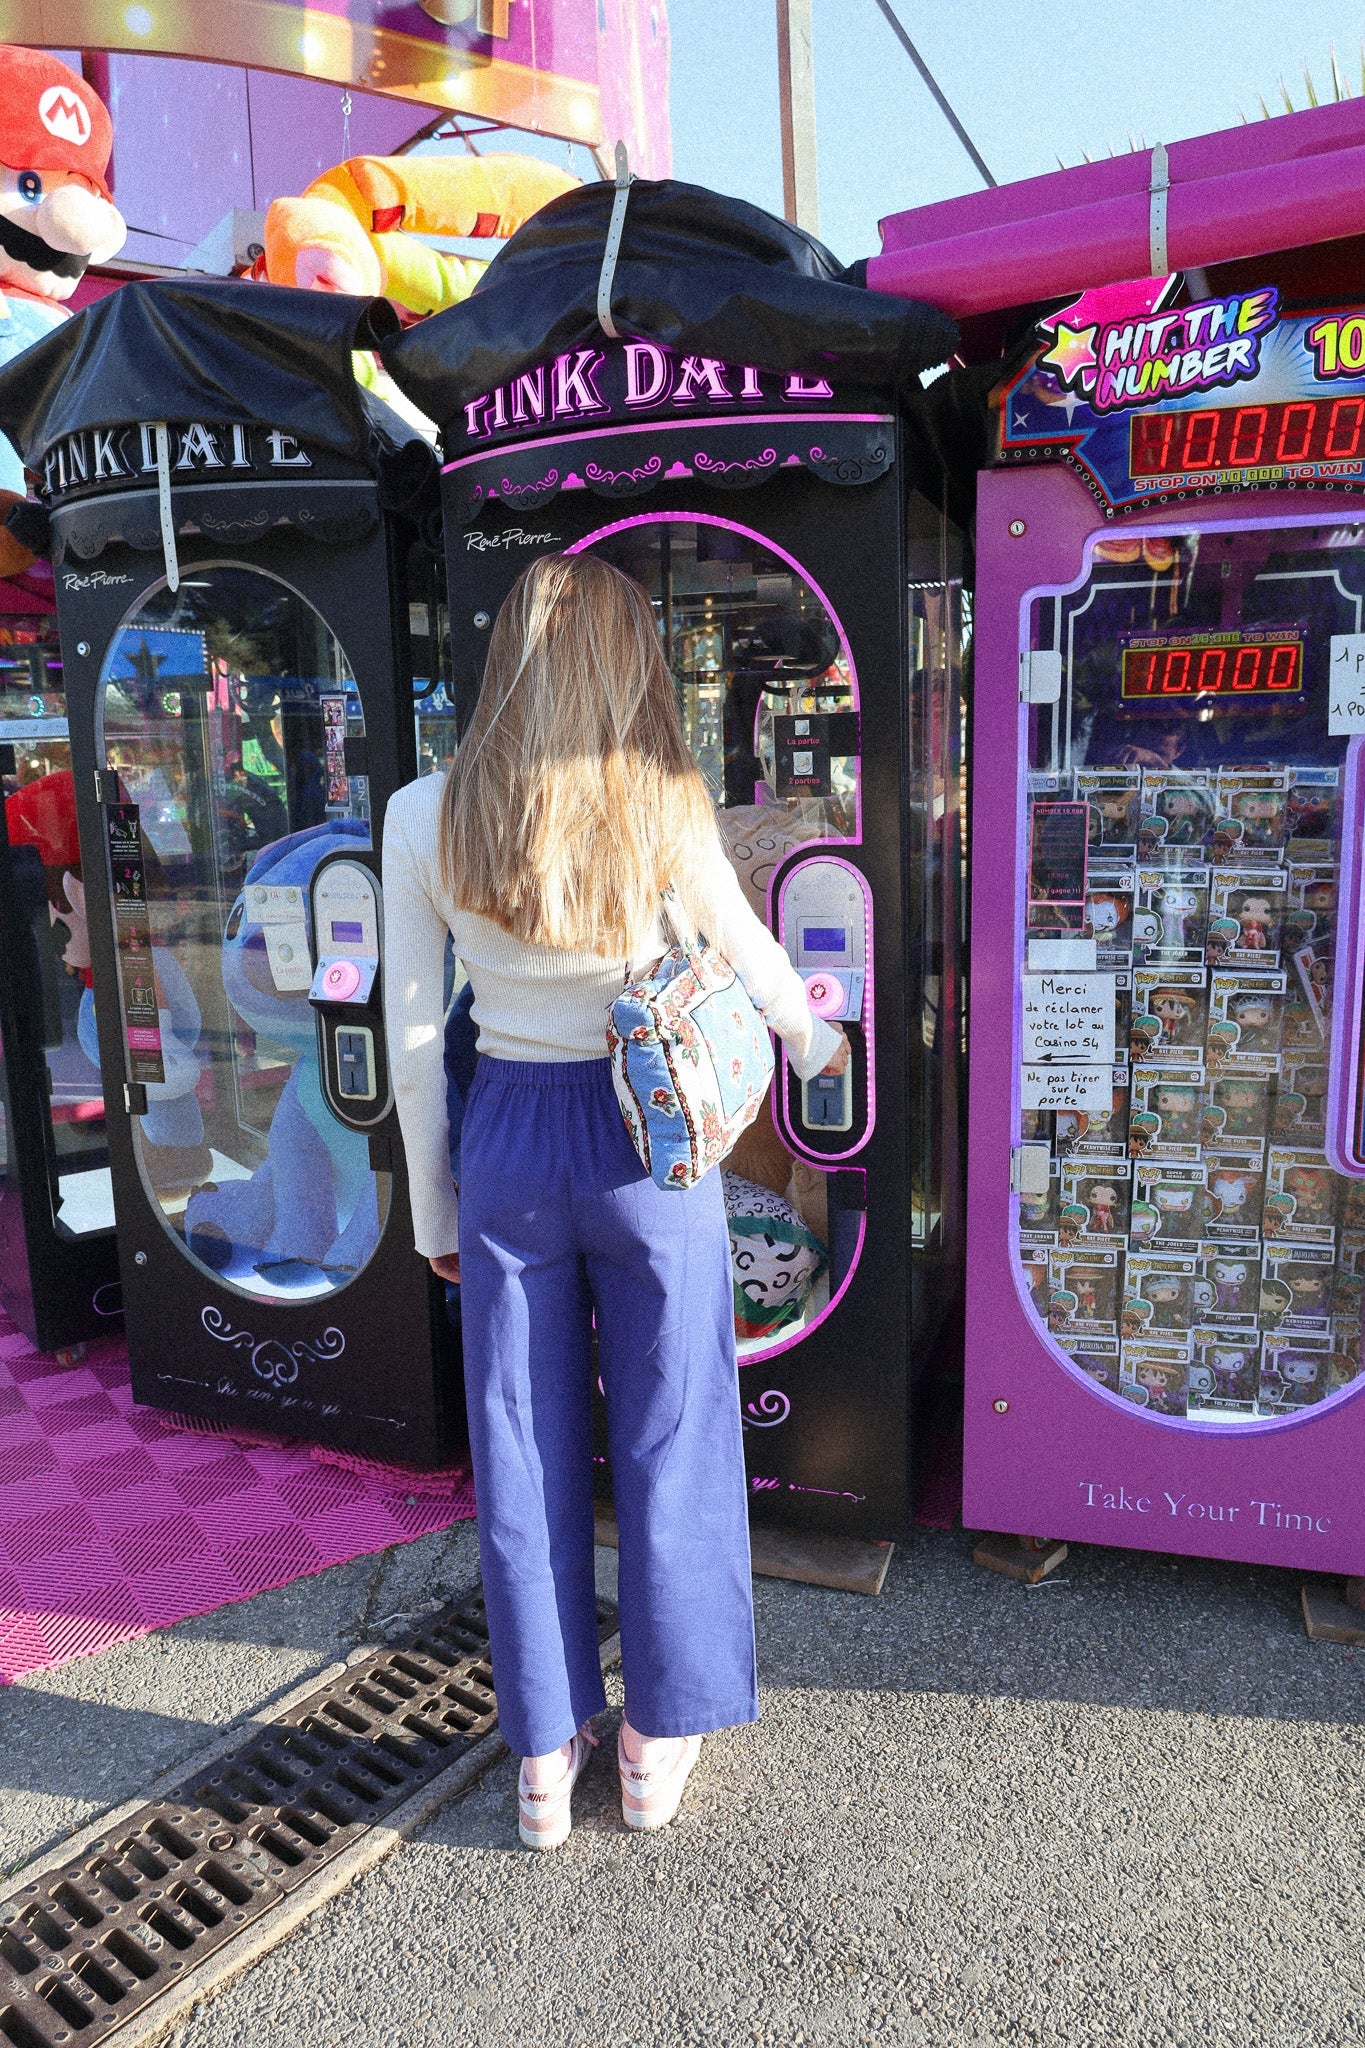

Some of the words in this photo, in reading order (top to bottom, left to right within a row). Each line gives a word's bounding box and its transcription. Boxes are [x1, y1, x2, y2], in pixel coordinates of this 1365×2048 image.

[1104, 315, 1178, 367] HIT
[1184, 292, 1271, 345] THE
[1101, 339, 1252, 405] NUMBER
[45, 430, 127, 494] PINK
[1134, 478, 1184, 492] STOP
[1187, 473, 1217, 488] ON
[1287, 467, 1315, 478] TO
[1317, 463, 1362, 476] WIN
[502, 529, 561, 549] Pierre
[1130, 638, 1168, 649] STOP
[1170, 635, 1191, 646] ON
[1243, 632, 1264, 643] TO
[1266, 630, 1299, 641] WIN
[1146, 646, 1298, 692] 10.000
[1135, 972, 1158, 983] POP!
[1214, 979, 1238, 989] POP!
[1041, 978, 1087, 995] Merci
[1025, 1001, 1039, 1012] de
[1045, 1001, 1103, 1014] réclamer
[1029, 1019, 1060, 1031] votre
[1065, 1018, 1085, 1030] lot
[1091, 1023, 1104, 1031] au
[1034, 1036, 1077, 1048] Casino
[1082, 1037, 1099, 1050] 54
[1027, 1071, 1041, 1083] Ne
[1047, 1074, 1066, 1086] pas
[1070, 1071, 1100, 1083] tirer
[1135, 1070, 1159, 1081] POP!
[1051, 1086, 1070, 1094] sur
[1075, 1085, 1087, 1094] la
[1038, 1095, 1078, 1107] porte
[1138, 1167, 1160, 1178] POP!
[1079, 1481, 1151, 1513] Take
[1163, 1491, 1240, 1523] Your
[1250, 1499, 1331, 1534] Time
[630, 1770, 651, 1782] NIKE
[527, 1792, 549, 1803] NIKE
